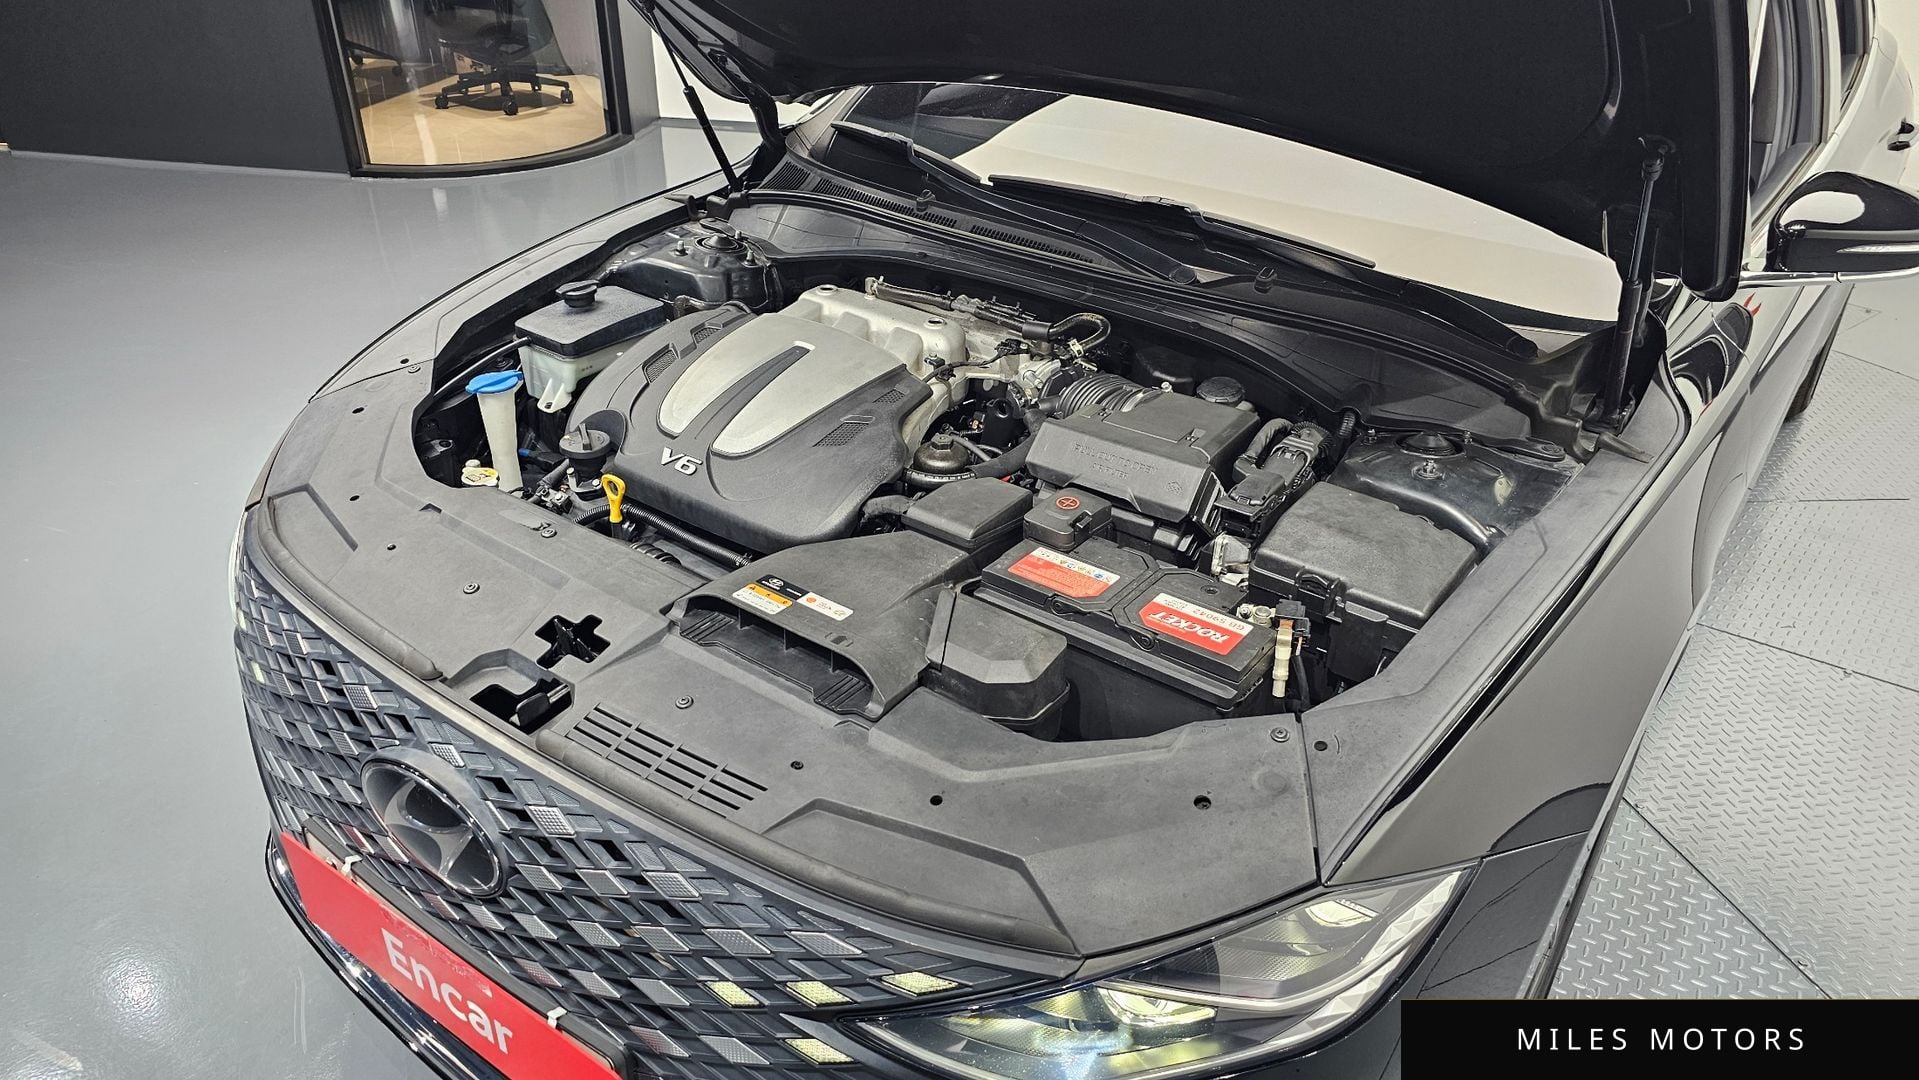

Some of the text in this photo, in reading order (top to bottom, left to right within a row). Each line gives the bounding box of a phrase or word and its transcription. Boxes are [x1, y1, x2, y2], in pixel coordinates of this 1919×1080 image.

[661, 446, 703, 476] V6
[1149, 611, 1230, 643] ROCKET
[381, 927, 513, 1055] Encar
